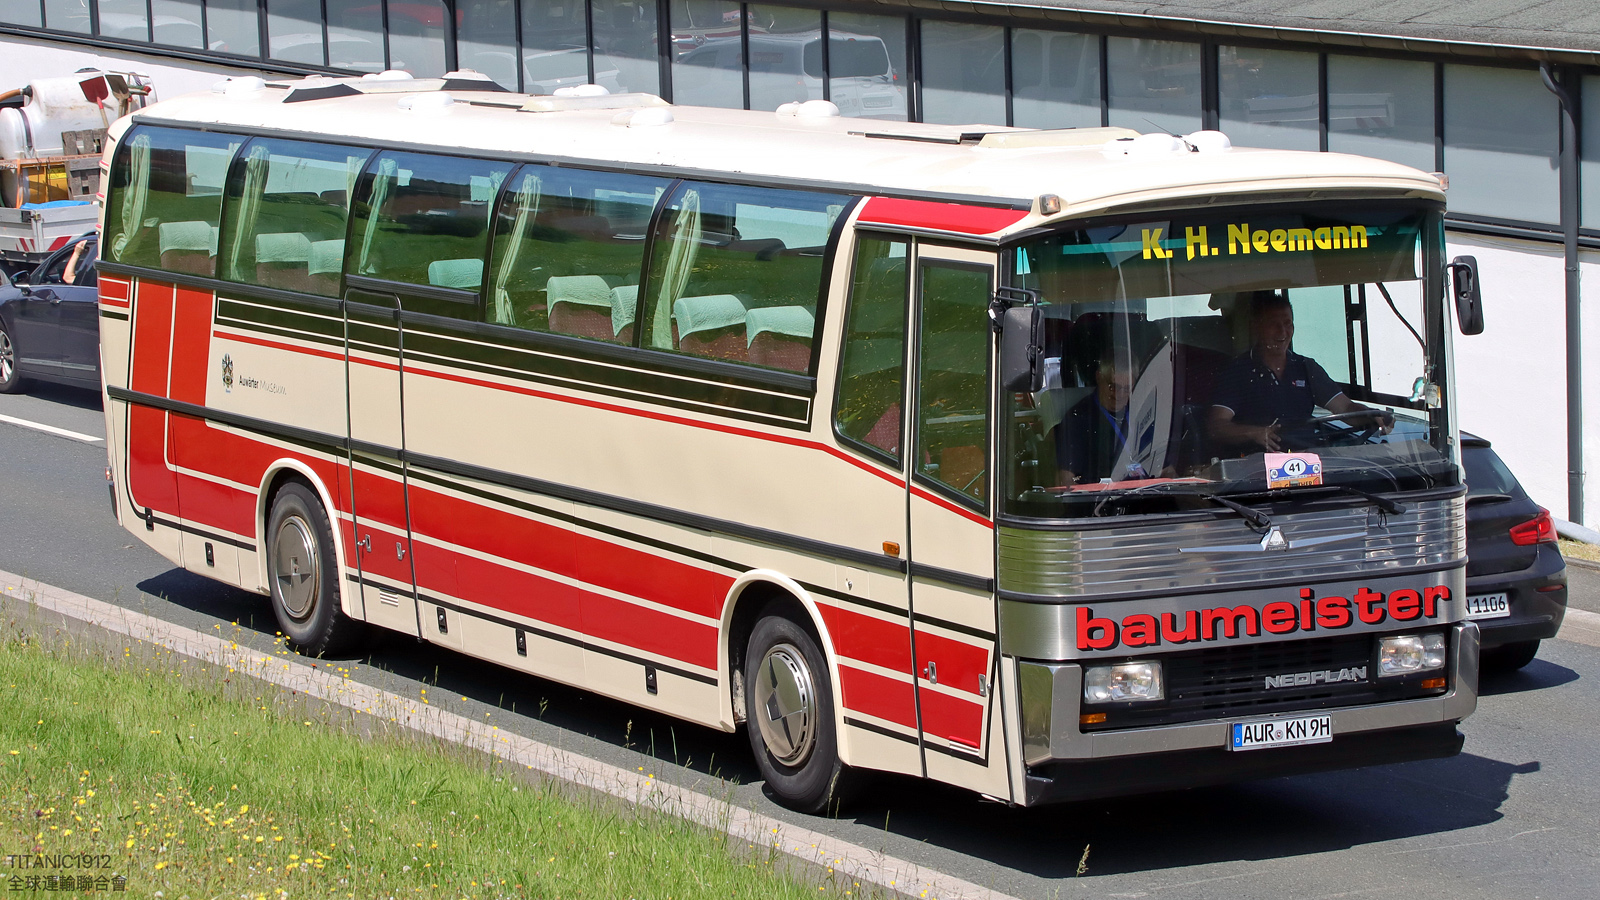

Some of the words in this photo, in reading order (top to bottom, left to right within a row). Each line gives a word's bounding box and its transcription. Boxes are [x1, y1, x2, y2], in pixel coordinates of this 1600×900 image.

[1141, 228, 1173, 260] K.
[1185, 225, 1219, 262] H.
[1227, 223, 1368, 255] Neemann
[1288, 462, 1301, 473] 41
[1473, 595, 1506, 613] 1106
[1076, 584, 1453, 651] baumeister
[1264, 665, 1367, 689] NEOPLAN
[1243, 723, 1275, 744] AUR
[1285, 720, 1307, 739] KN
[1310, 717, 1330, 737] 9H
